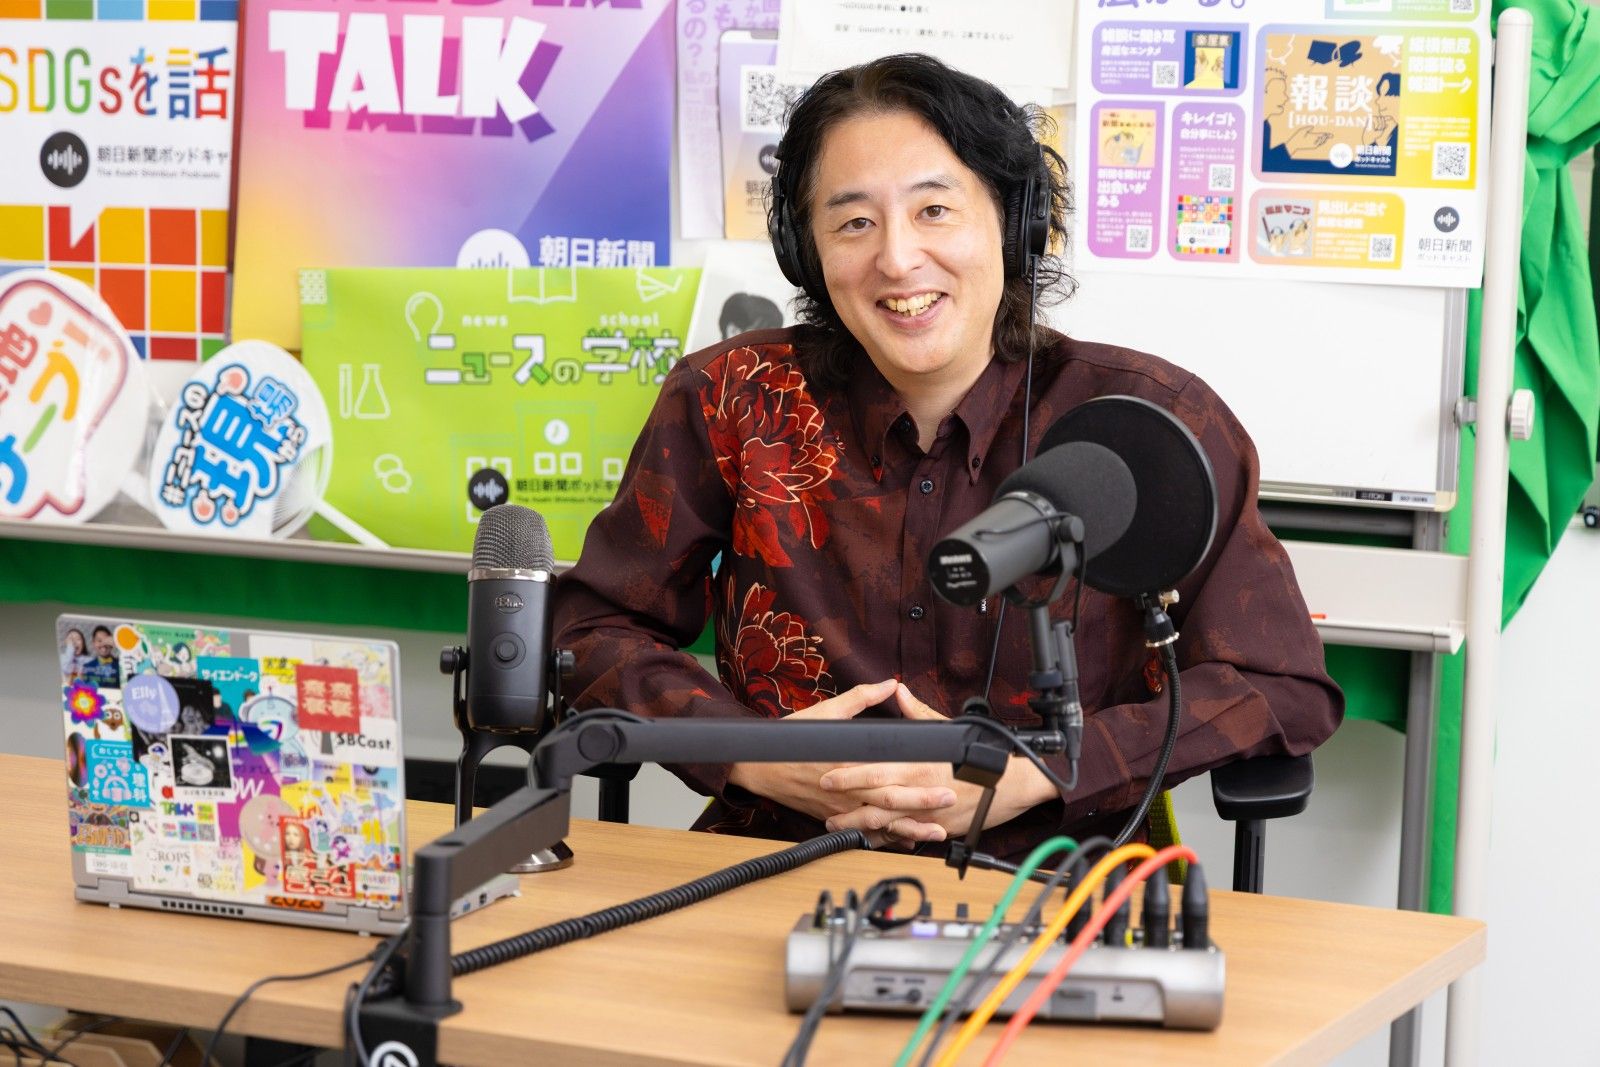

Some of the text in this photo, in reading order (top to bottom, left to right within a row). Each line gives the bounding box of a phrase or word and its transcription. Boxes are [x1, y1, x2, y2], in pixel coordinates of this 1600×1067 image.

[268, 10, 549, 124] TALK
[1181, 111, 1237, 127] キレイゴト
[539, 235, 656, 268] 朝日新聞
[1418, 237, 1473, 253] 朝日新聞
[462, 312, 660, 328] news school
[424, 327, 682, 386] ニュースの学校
[336, 733, 391, 750] SBCast
[160, 801, 195, 817] TALK
